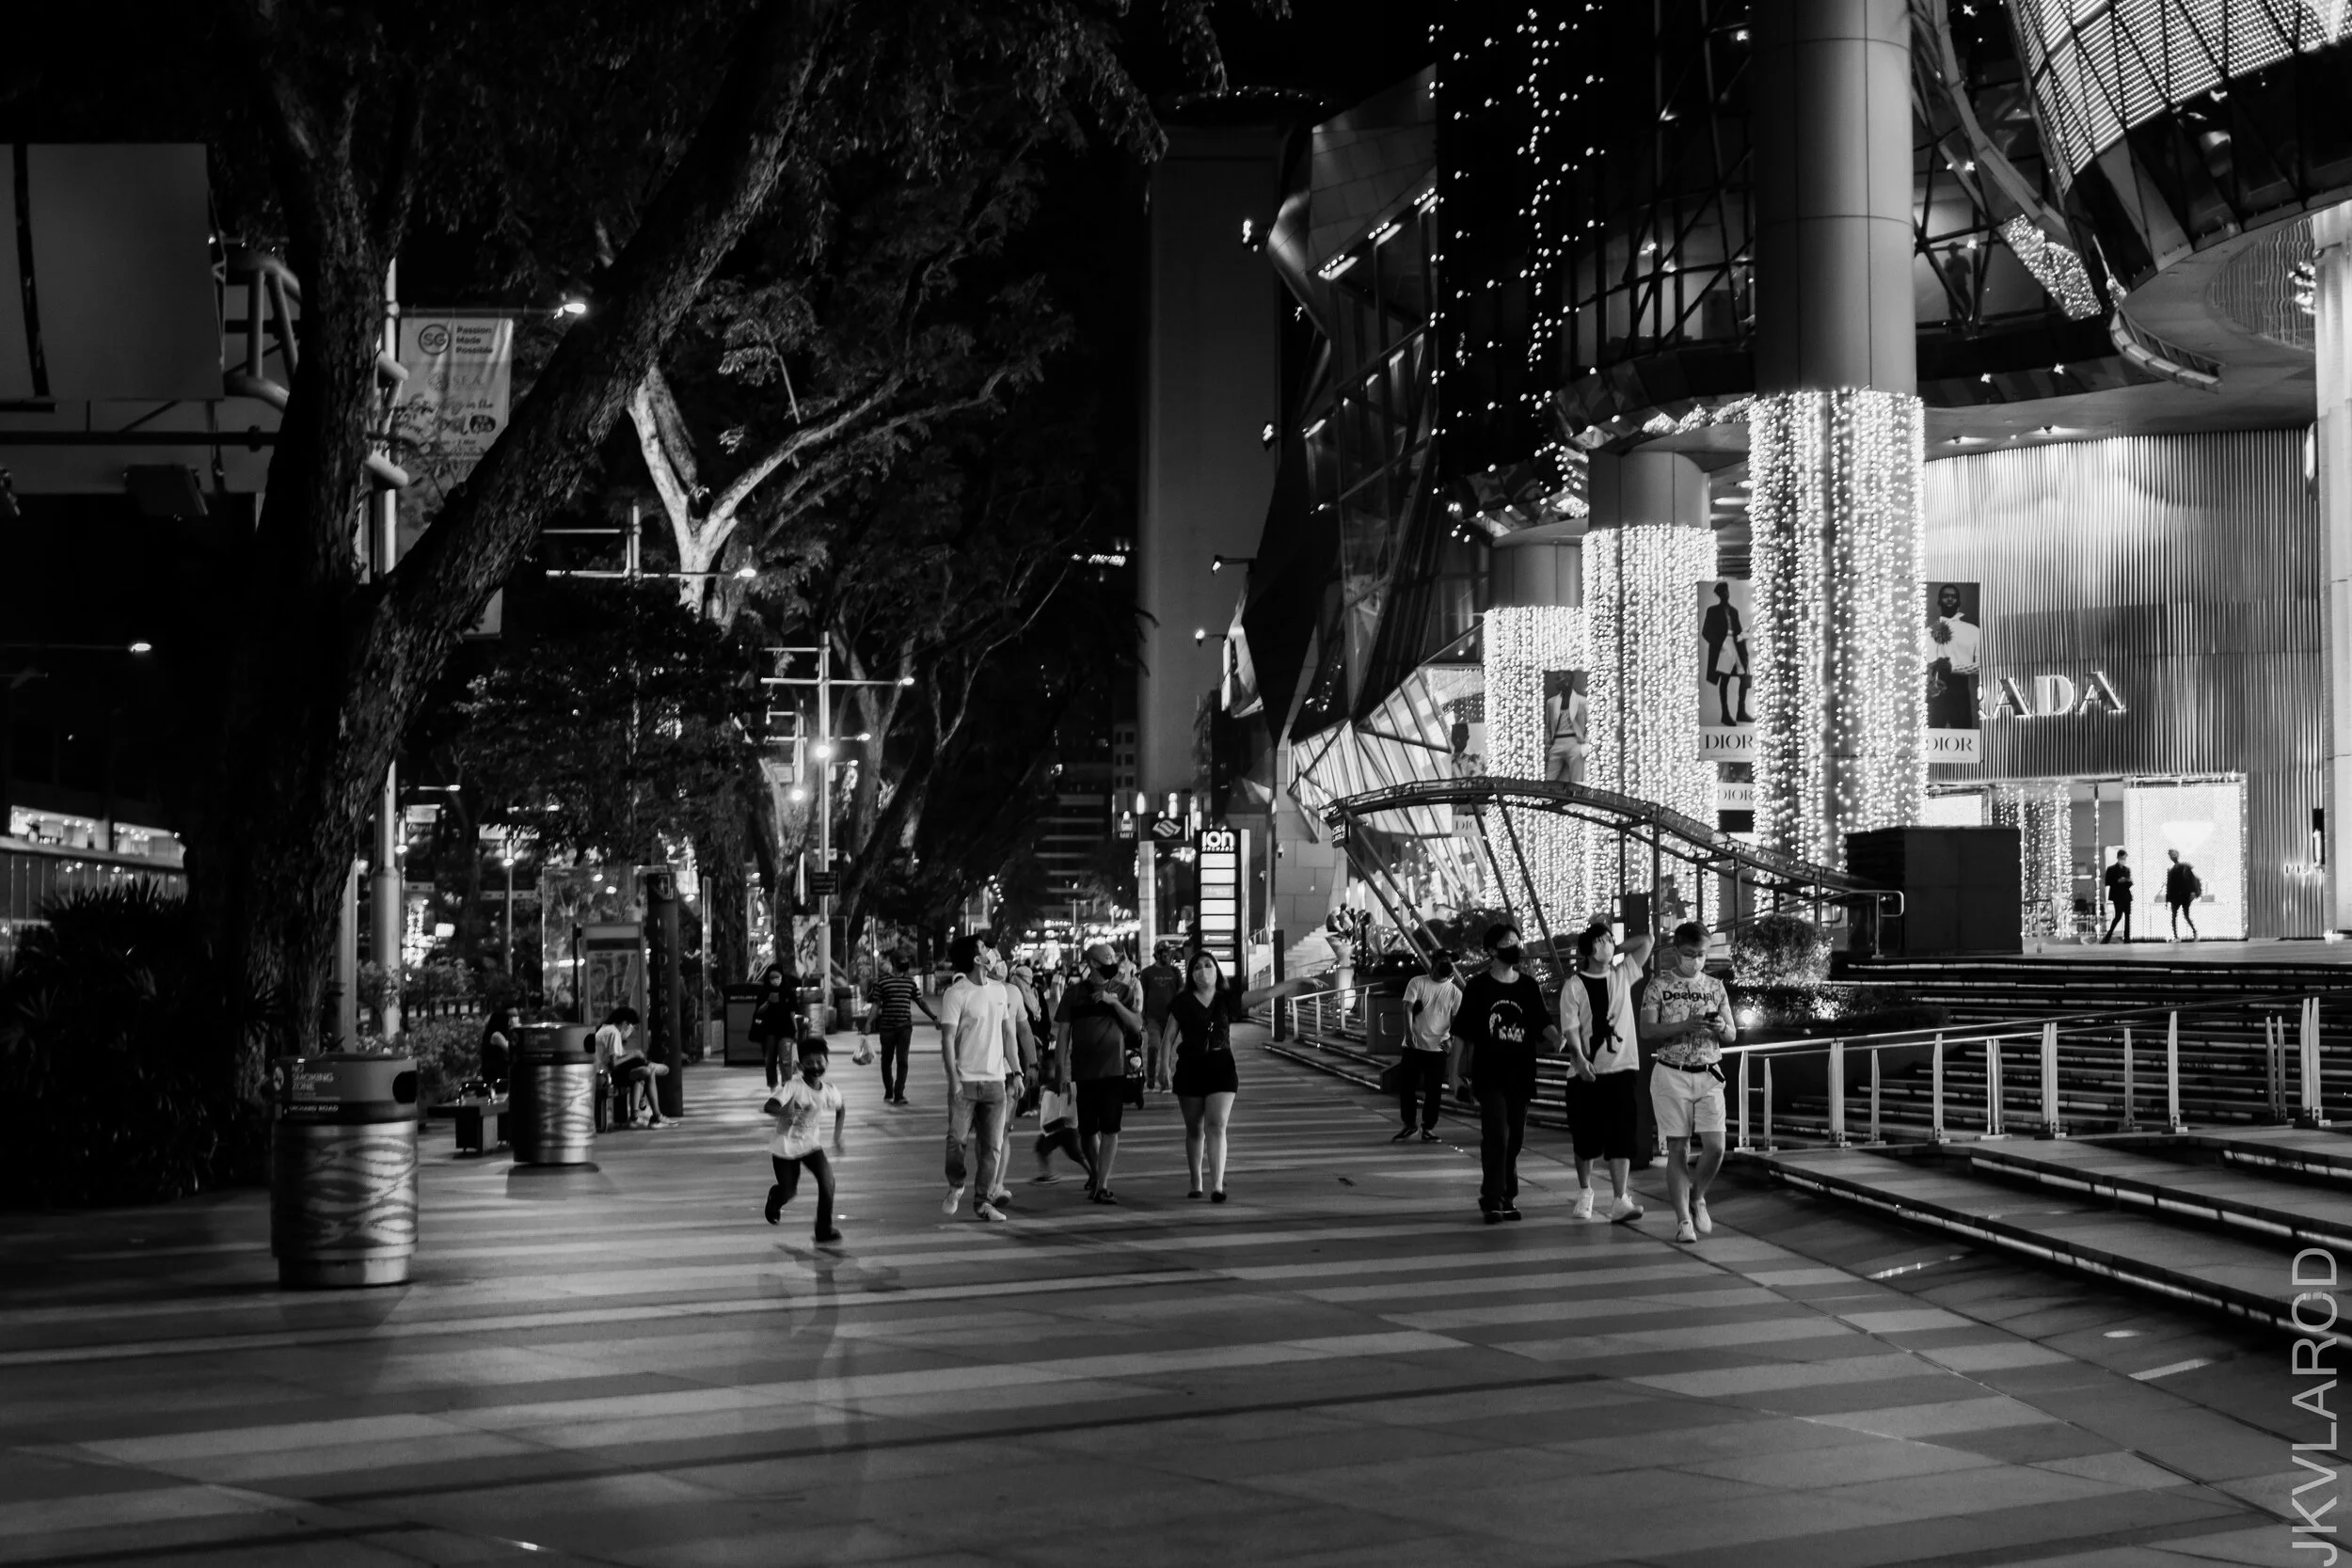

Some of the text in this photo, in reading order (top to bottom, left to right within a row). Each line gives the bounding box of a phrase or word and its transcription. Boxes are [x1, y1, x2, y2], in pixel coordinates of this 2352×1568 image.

[423, 332, 447, 347] SG
[1705, 735, 1754, 750] DIOR
[658, 917, 671, 1055] UNDERPAS
[292, 1072, 334, 1083] SMOKING
[292, 1081, 315, 1091] ZONE
